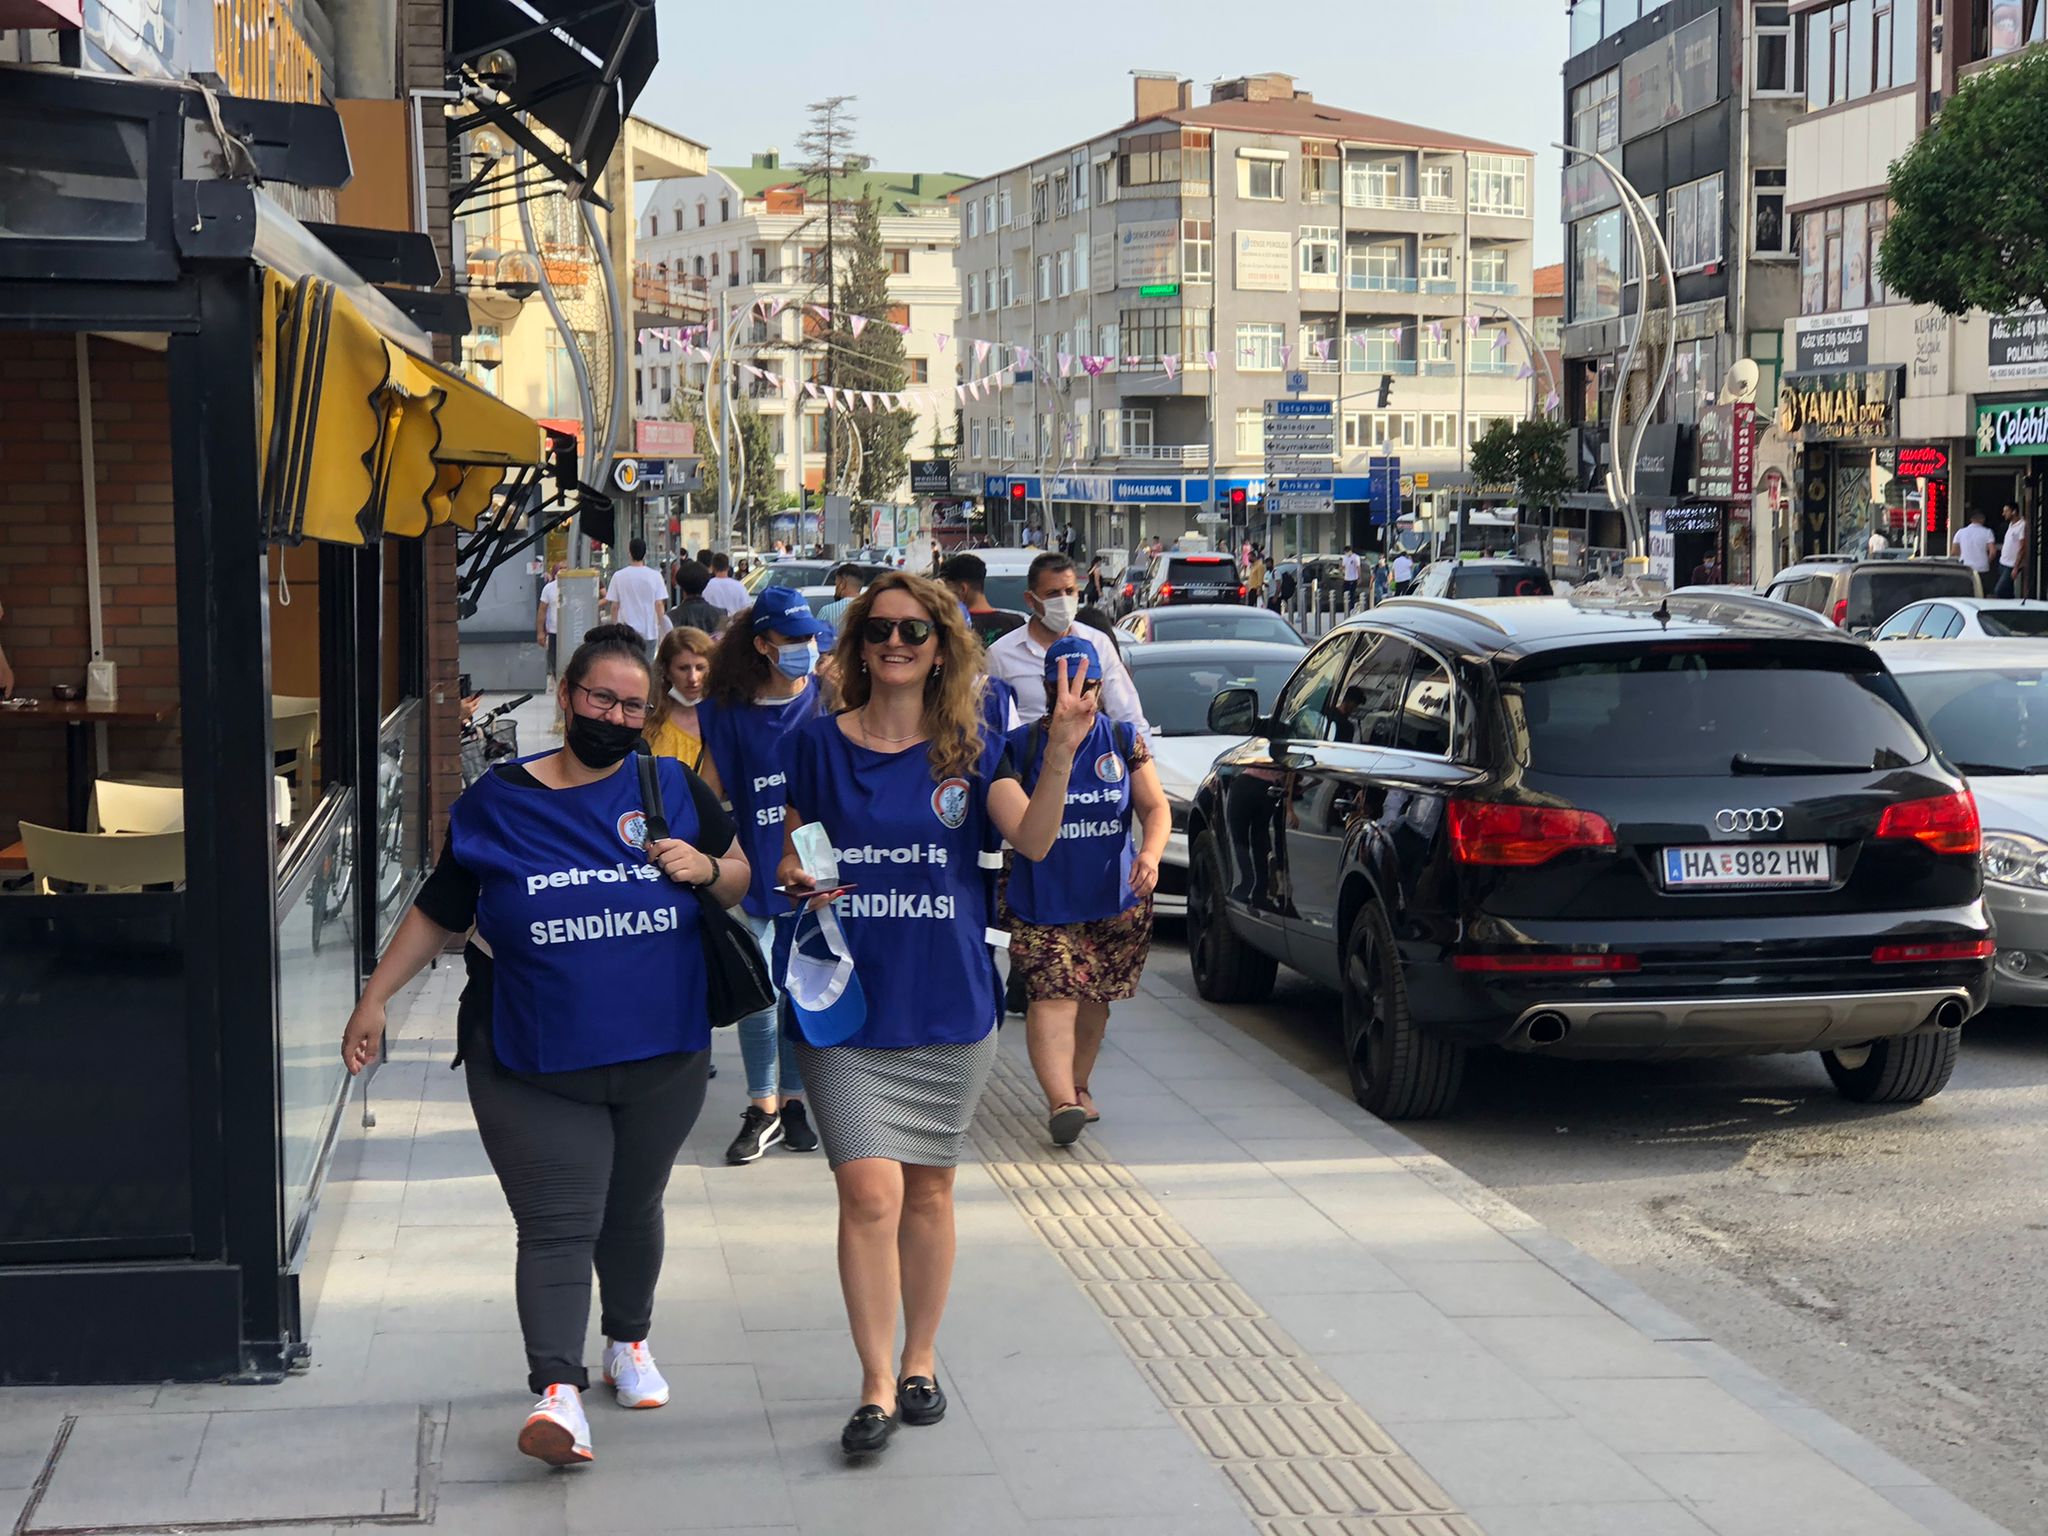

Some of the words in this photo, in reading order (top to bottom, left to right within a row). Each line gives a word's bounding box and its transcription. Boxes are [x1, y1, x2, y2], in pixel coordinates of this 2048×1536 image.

[1817, 333, 1825, 347] VE
[1799, 390, 1859, 423] YAMAN
[1738, 428, 1750, 491] ANADOLU
[1899, 447, 1936, 461] KUAFÖR
[1897, 462, 1936, 476] SELÇUK
[1127, 484, 1173, 497] HALKBANK
[1281, 480, 1321, 490] Ankara
[1684, 852, 1718, 878] HA
[1735, 851, 1782, 876] 982
[1787, 849, 1820, 875] HW
[527, 862, 662, 896] petrol-iş
[836, 887, 956, 920] ENDİKASI
[530, 905, 678, 946] SENDİKASI
